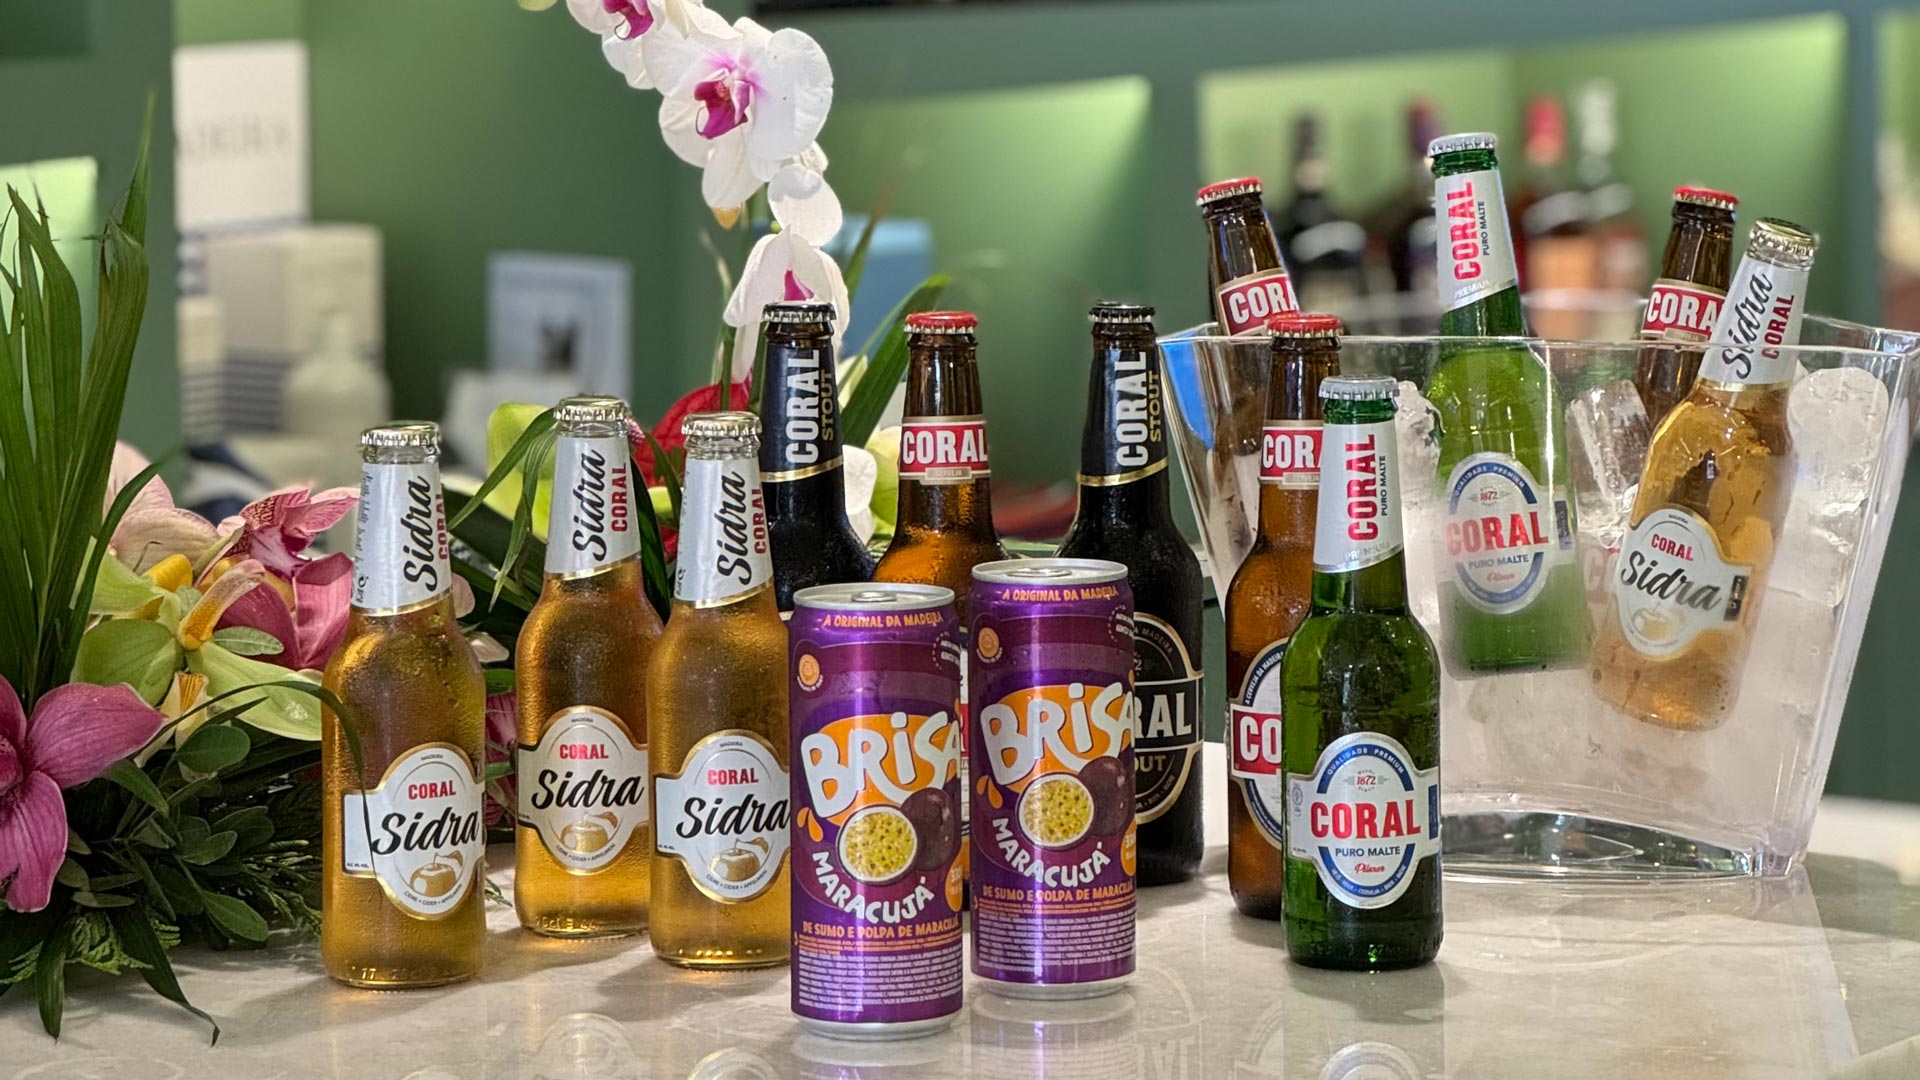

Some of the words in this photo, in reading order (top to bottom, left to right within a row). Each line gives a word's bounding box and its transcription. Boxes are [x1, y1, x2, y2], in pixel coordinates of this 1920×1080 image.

[1447, 181, 1482, 281] CORAL
[1477, 200, 1488, 229] MALTE
[1481, 231, 1490, 256] PURO
[1228, 282, 1299, 325] CORA
[1646, 291, 1723, 331] CORA
[1722, 273, 1773, 379] Sidra
[1761, 294, 1795, 360] CORAL
[785, 349, 820, 463] CORAL
[821, 369, 834, 441] STOUT
[1114, 351, 1149, 467] CORAL
[1148, 370, 1161, 443] STOUT
[902, 428, 988, 465] CORAL
[1262, 434, 1323, 469] COR
[1344, 433, 1379, 541] CORAL
[1378, 455, 1386, 488] MALTE
[1454, 465, 1487, 496] QUALIDADE
[1493, 465, 1525, 488] PREMIUM
[572, 449, 607, 562] Sidra
[611, 463, 628, 532] CORAL
[400, 475, 438, 592] Sidra
[713, 470, 752, 585] Sidra
[1444, 511, 1549, 556] CORAL
[1651, 533, 1694, 562] CORAL
[1468, 559, 1495, 569] PURO
[1496, 554, 1530, 566] MALTE
[1621, 550, 1722, 611] Sidra
[1002, 588, 1010, 600] A
[1012, 588, 1061, 602] ORIGINAL
[1063, 588, 1079, 601] DA
[1080, 585, 1119, 601] MADEIRA
[822, 614, 831, 626] A
[833, 614, 883, 628] ORIGINAL
[886, 614, 902, 627] DA
[904, 610, 943, 627] MADEIRA
[1142, 628, 1173, 654] MADEIRA
[1134, 692, 1192, 738] RAL
[559, 743, 609, 760] CORAL
[1327, 747, 1368, 775] QUALIDADE
[1373, 748, 1405, 774] PREMIUM
[408, 780, 456, 800] CORAL
[531, 769, 645, 810] Sidra
[707, 767, 759, 786] CORAL
[1356, 775, 1377, 785] 1872
[371, 807, 480, 855] Sidra
[675, 793, 791, 839] Sidra
[1310, 799, 1421, 839] CORAL
[992, 817, 1112, 888] MARACUJÁ
[1335, 847, 1365, 857] PURO
[1367, 845, 1401, 857] MALTE
[812, 851, 935, 924] MARACUJÁ
[983, 884, 993, 896] DE
[994, 886, 1024, 901] SUMO
[1027, 889, 1034, 901] E
[1035, 889, 1074, 902] POLPA
[1076, 888, 1090, 900] DE
[803, 921, 813, 932] DE
[814, 923, 844, 938] SUMO
[847, 926, 855, 938] E
[857, 926, 895, 939] POLPA
[898, 925, 913, 937] DE
